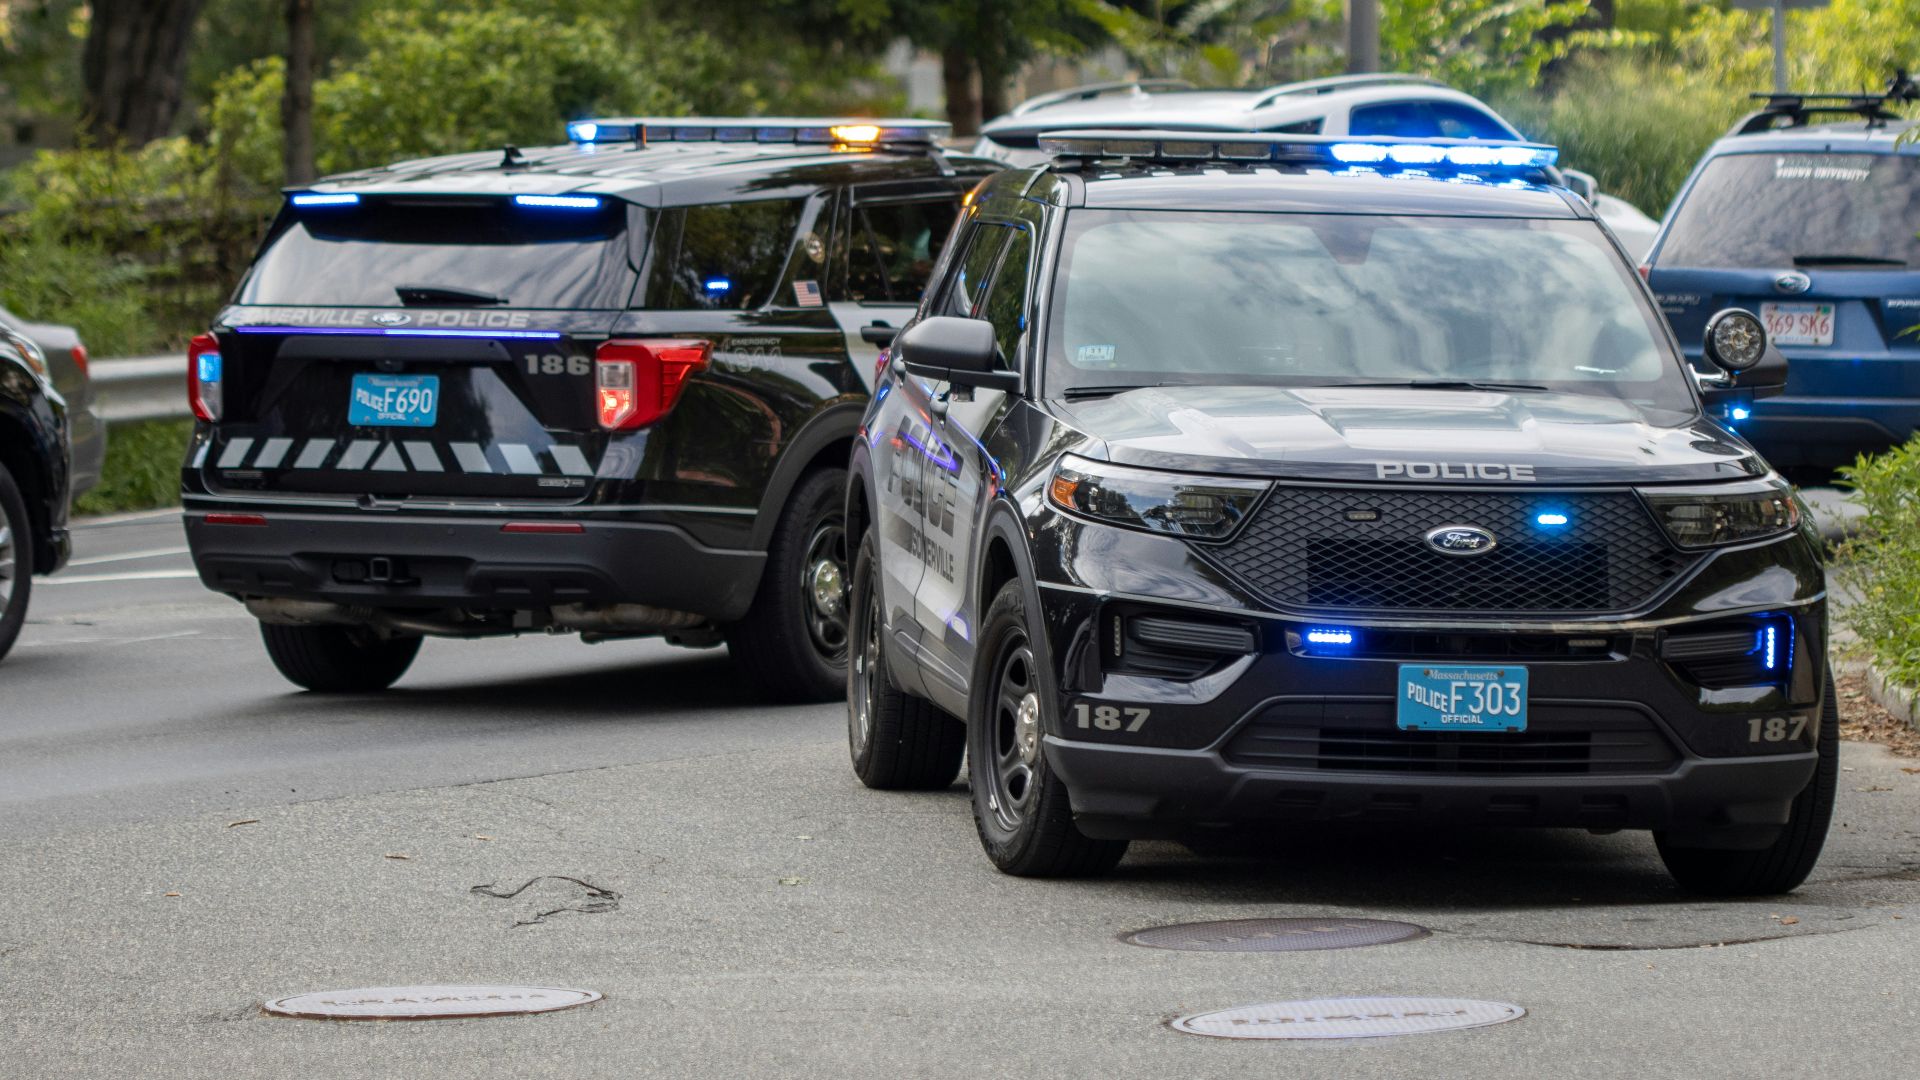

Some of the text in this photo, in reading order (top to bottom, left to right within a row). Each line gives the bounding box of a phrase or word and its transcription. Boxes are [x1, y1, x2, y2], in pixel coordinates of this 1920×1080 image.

[240, 308, 368, 325] MERVILLE
[418, 312, 530, 328] POLICE
[1765, 313, 1831, 336] 369 SK6
[524, 354, 590, 375] 186
[356, 387, 432, 414] POLICE F690
[1375, 462, 1537, 482] POLICE
[1428, 669, 1499, 681] Massachusetts
[1407, 681, 1521, 716] POLICE F303
[1074, 703, 1151, 732] 187
[1441, 714, 1483, 724] OFFICIAL
[1747, 715, 1808, 743] 187
